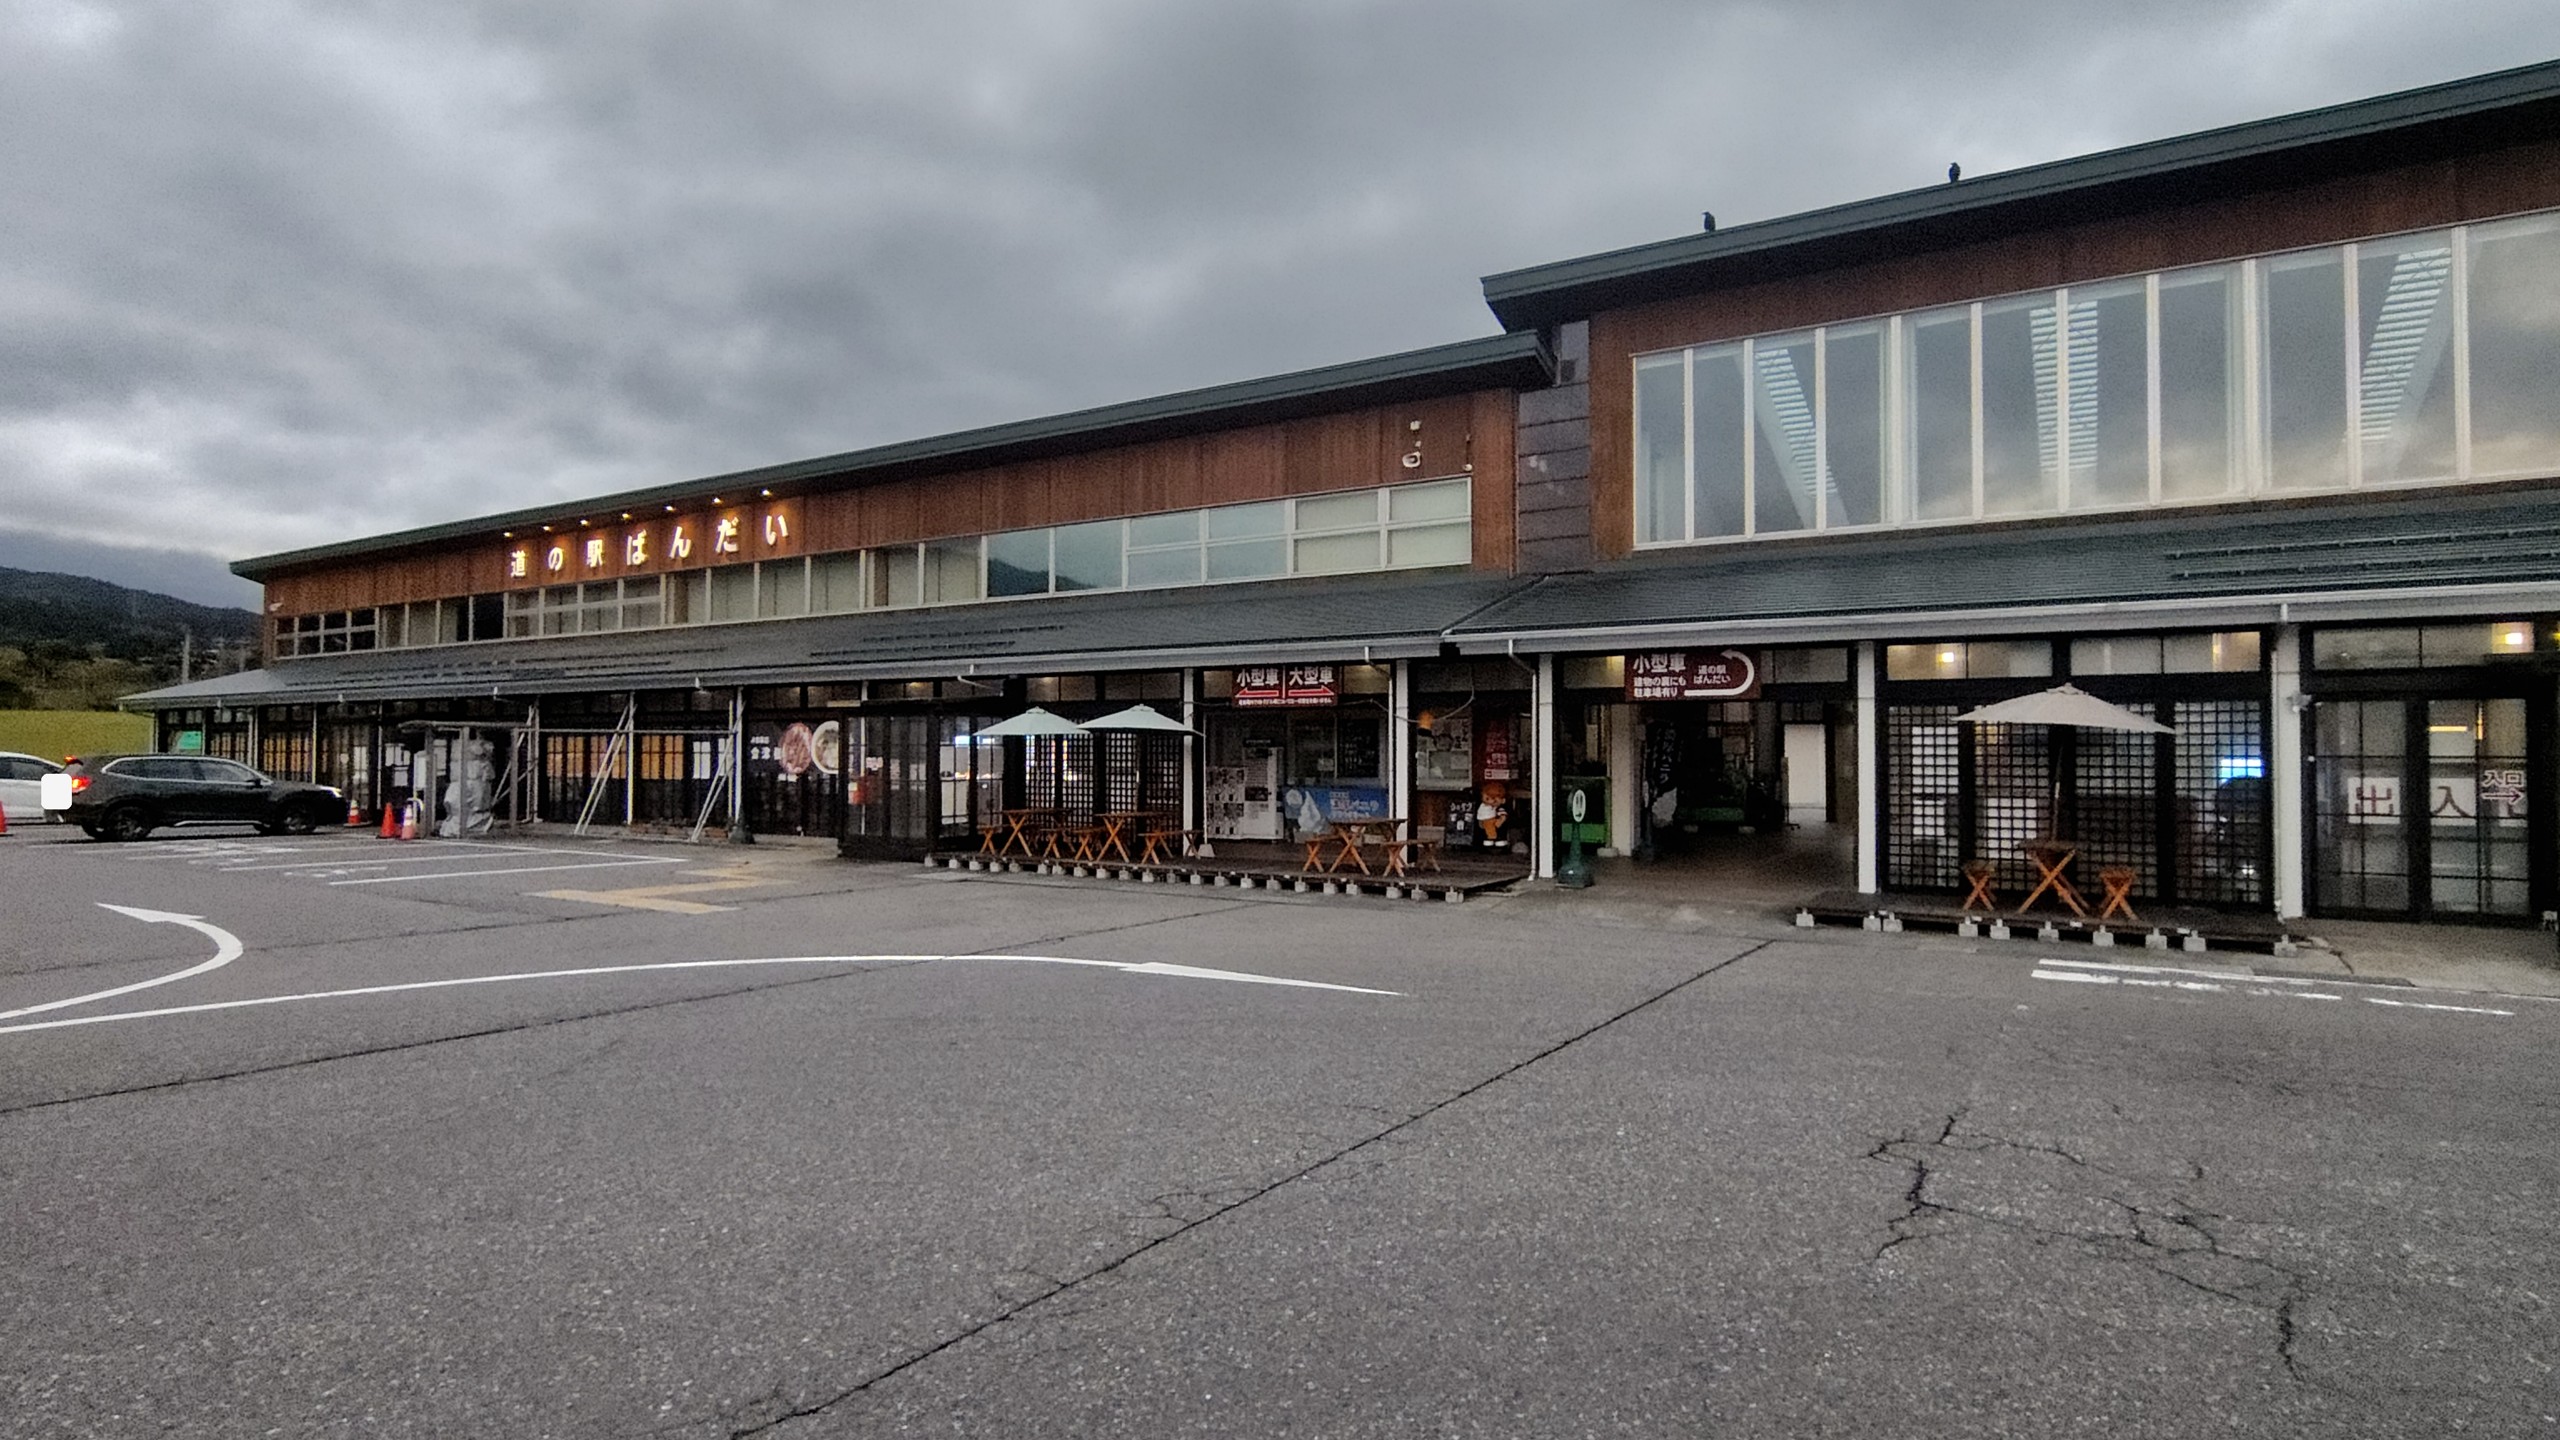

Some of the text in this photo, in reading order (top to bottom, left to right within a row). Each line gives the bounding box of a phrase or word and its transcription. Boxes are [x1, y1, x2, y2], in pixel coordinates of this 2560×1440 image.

[510, 514, 789, 578] 道の駅ばんだい
[1633, 652, 1686, 674] 小型車
[1698, 664, 1727, 675] 道の駅
[1236, 667, 1279, 687] 小型車
[1288, 666, 1335, 686] 大型車
[1693, 675, 1732, 685] ばんだい
[2482, 770, 2525, 787] 入口
